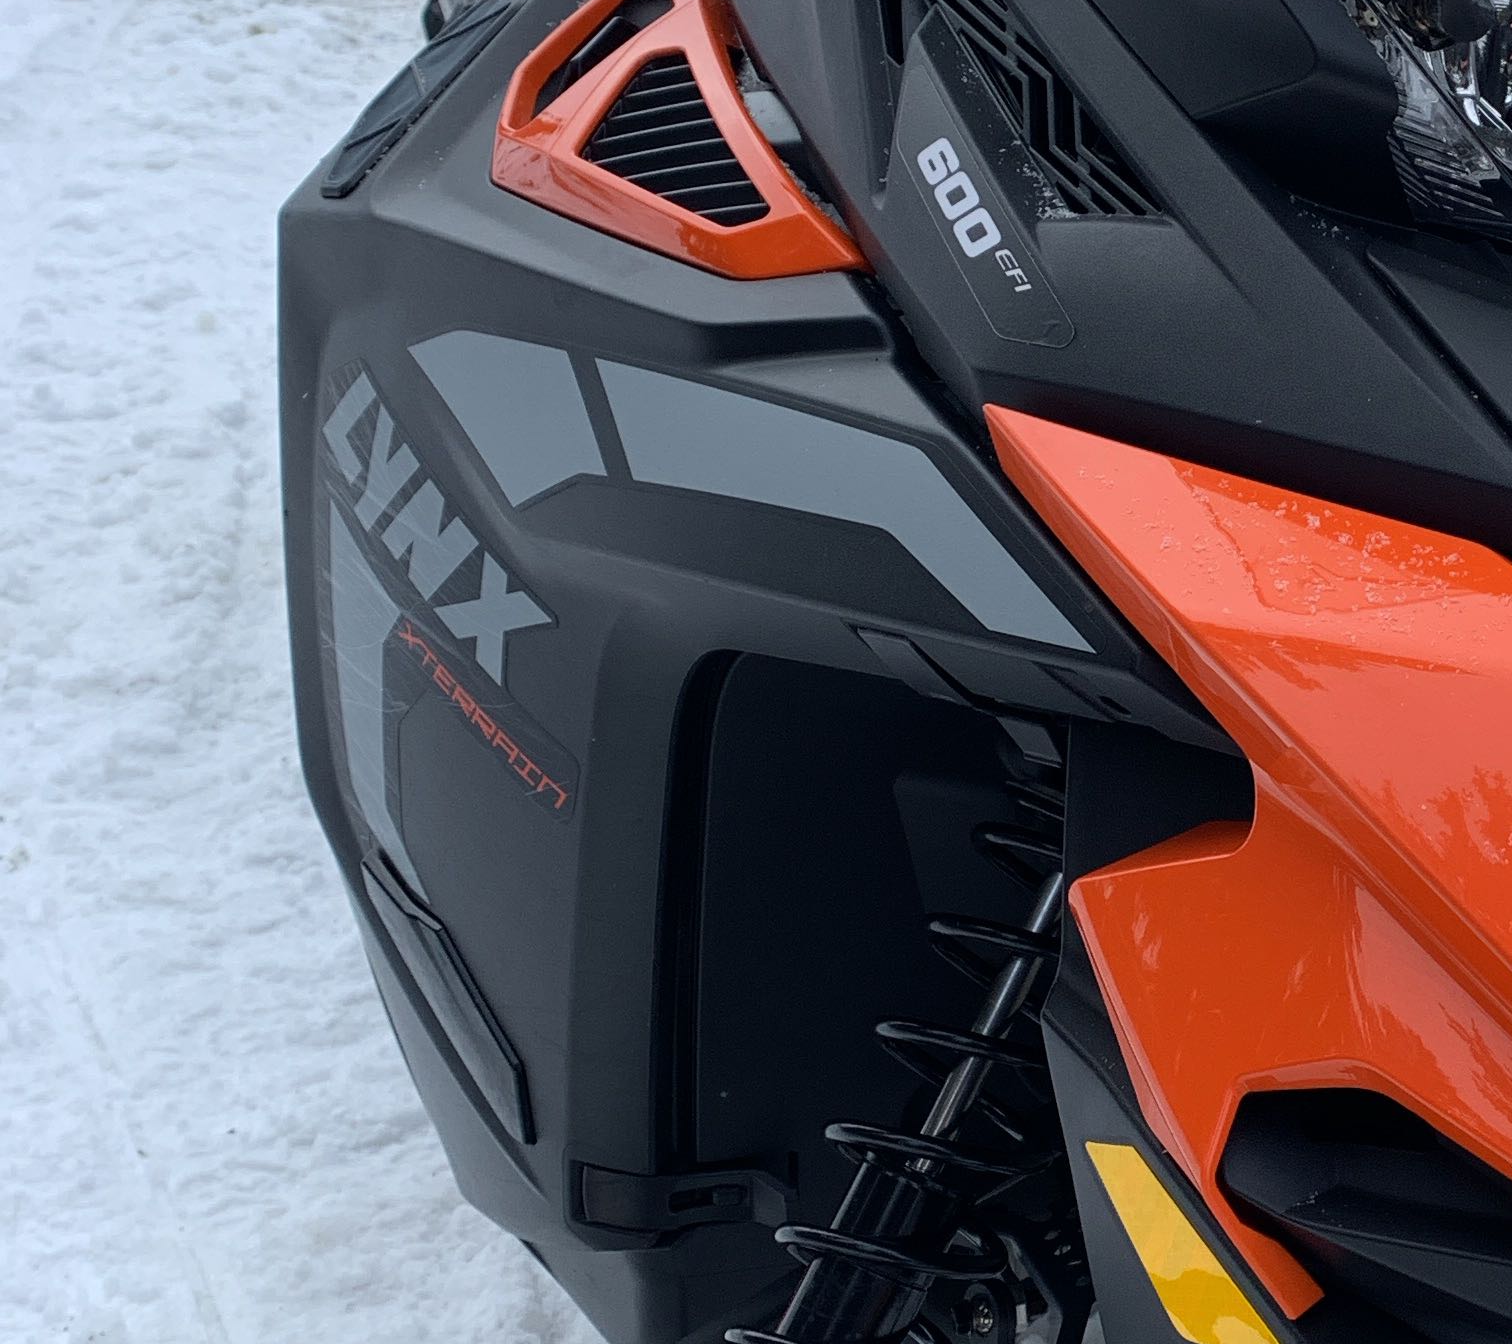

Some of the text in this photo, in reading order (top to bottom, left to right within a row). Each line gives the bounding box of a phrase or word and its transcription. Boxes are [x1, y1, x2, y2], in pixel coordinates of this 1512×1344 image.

[916, 136, 1033, 293] 600 EFI
[321, 371, 555, 687] LYNX
[397, 622, 570, 811] XTERRAIN
